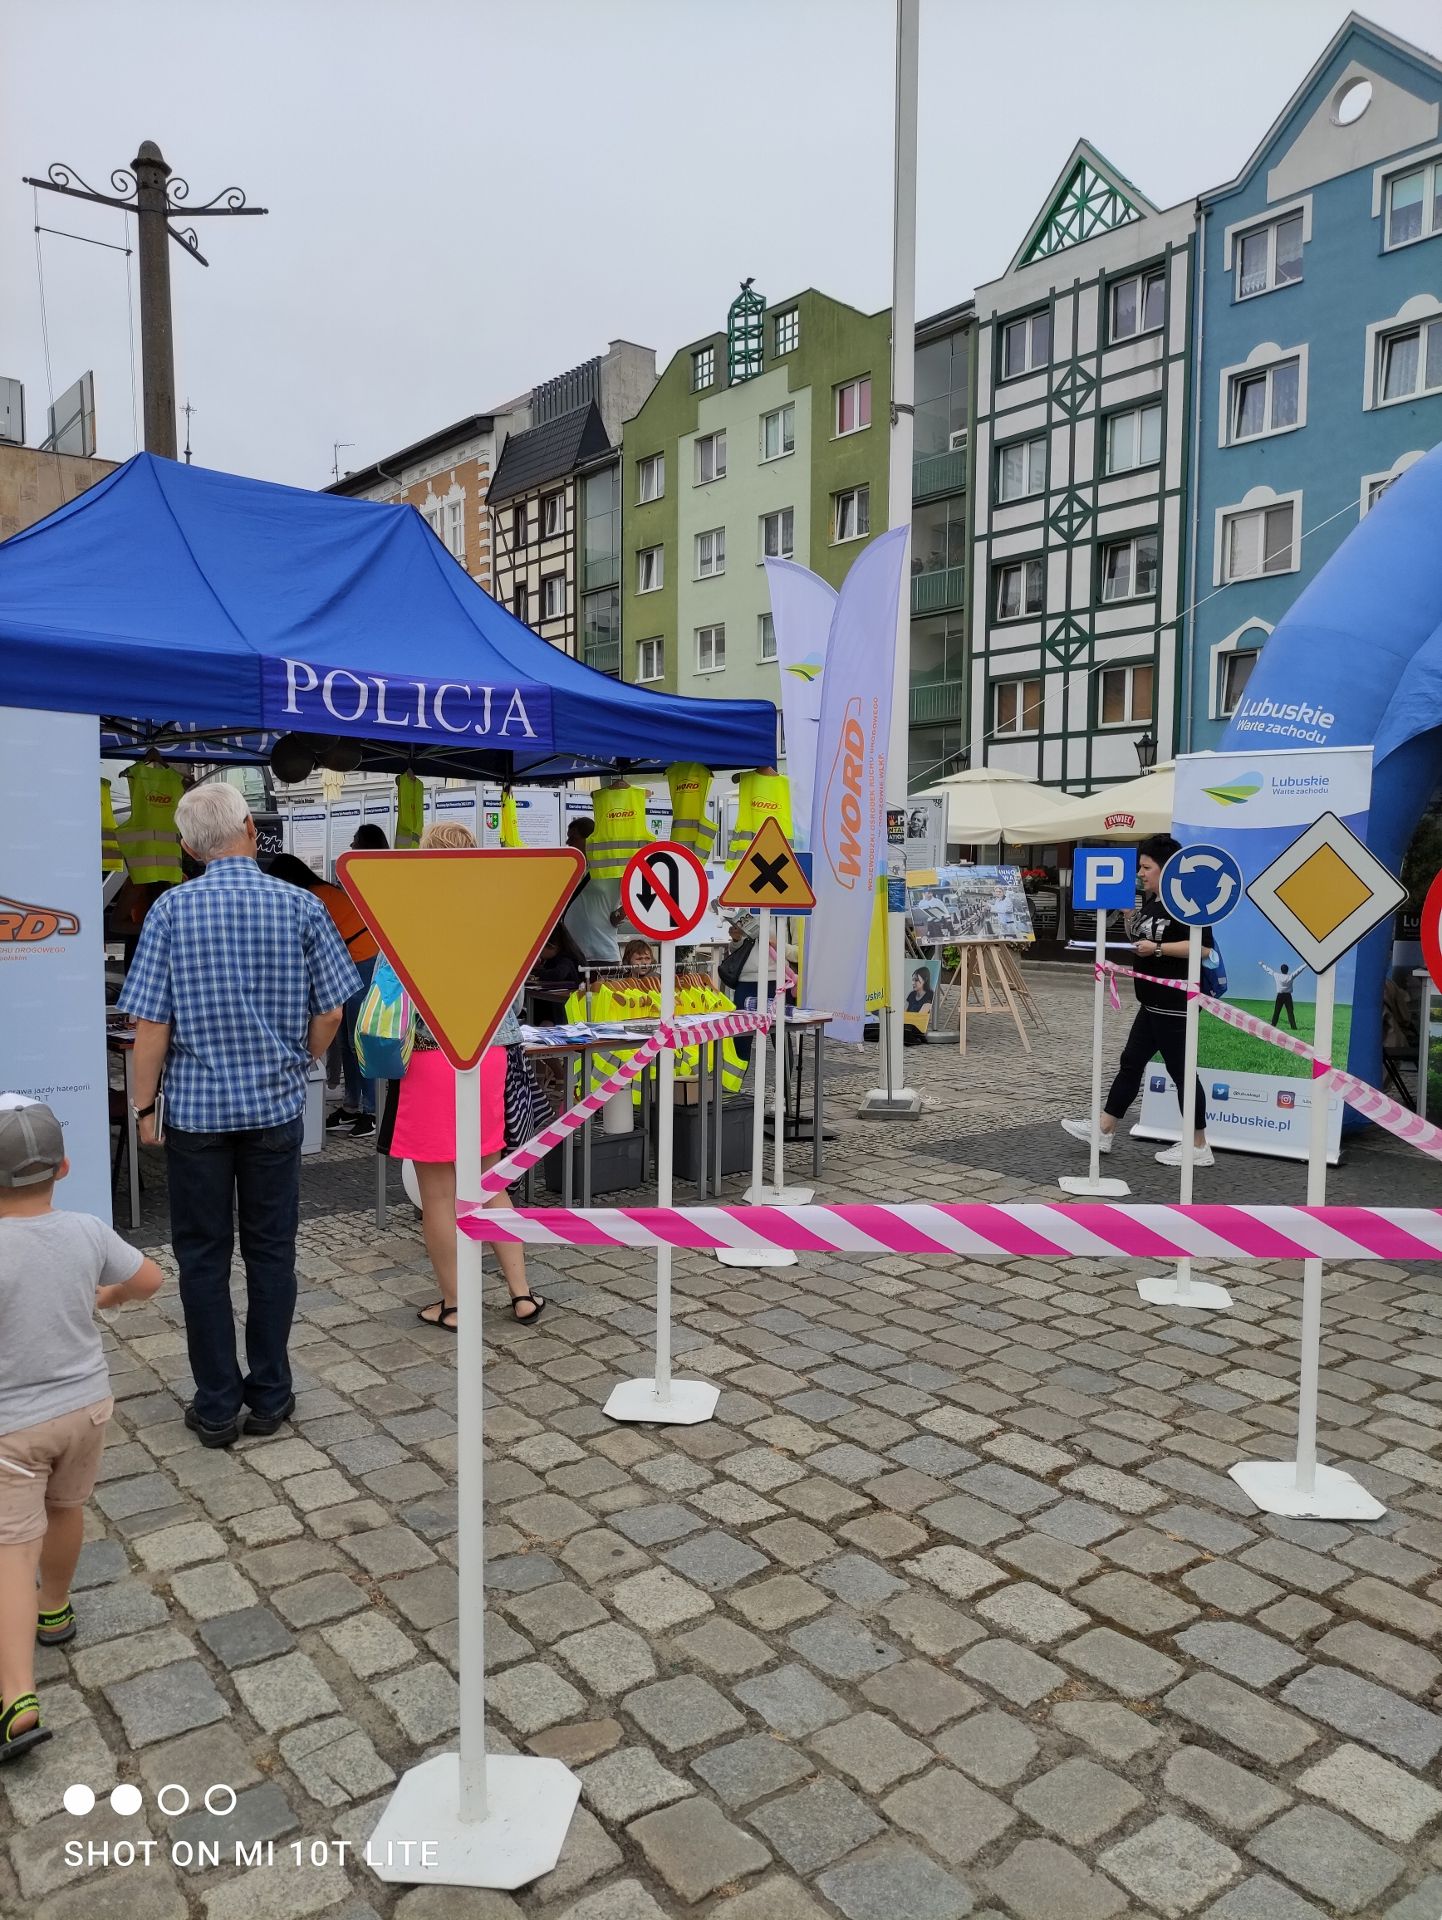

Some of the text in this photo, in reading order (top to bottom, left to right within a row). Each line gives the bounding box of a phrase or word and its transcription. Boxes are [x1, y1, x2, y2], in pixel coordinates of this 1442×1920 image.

[280, 658, 538, 738] POLICJA
[1241, 697, 1335, 729] Lubuskie
[1237, 719, 1327, 745] Warte zachodu
[676, 782, 700, 791] WORD
[1271, 775, 1330, 788] Lubuskie
[1296, 787, 1329, 795] zachodu
[839, 718, 865, 877] WORD
[751, 800, 778, 810] WORD
[607, 810, 635, 819] WORD
[1085, 856, 1125, 901] P
[15, 946, 66, 954] DROGOWEGO
[34, 1085, 55, 1095] jazdy
[56, 1083, 91, 1093] kategorii
